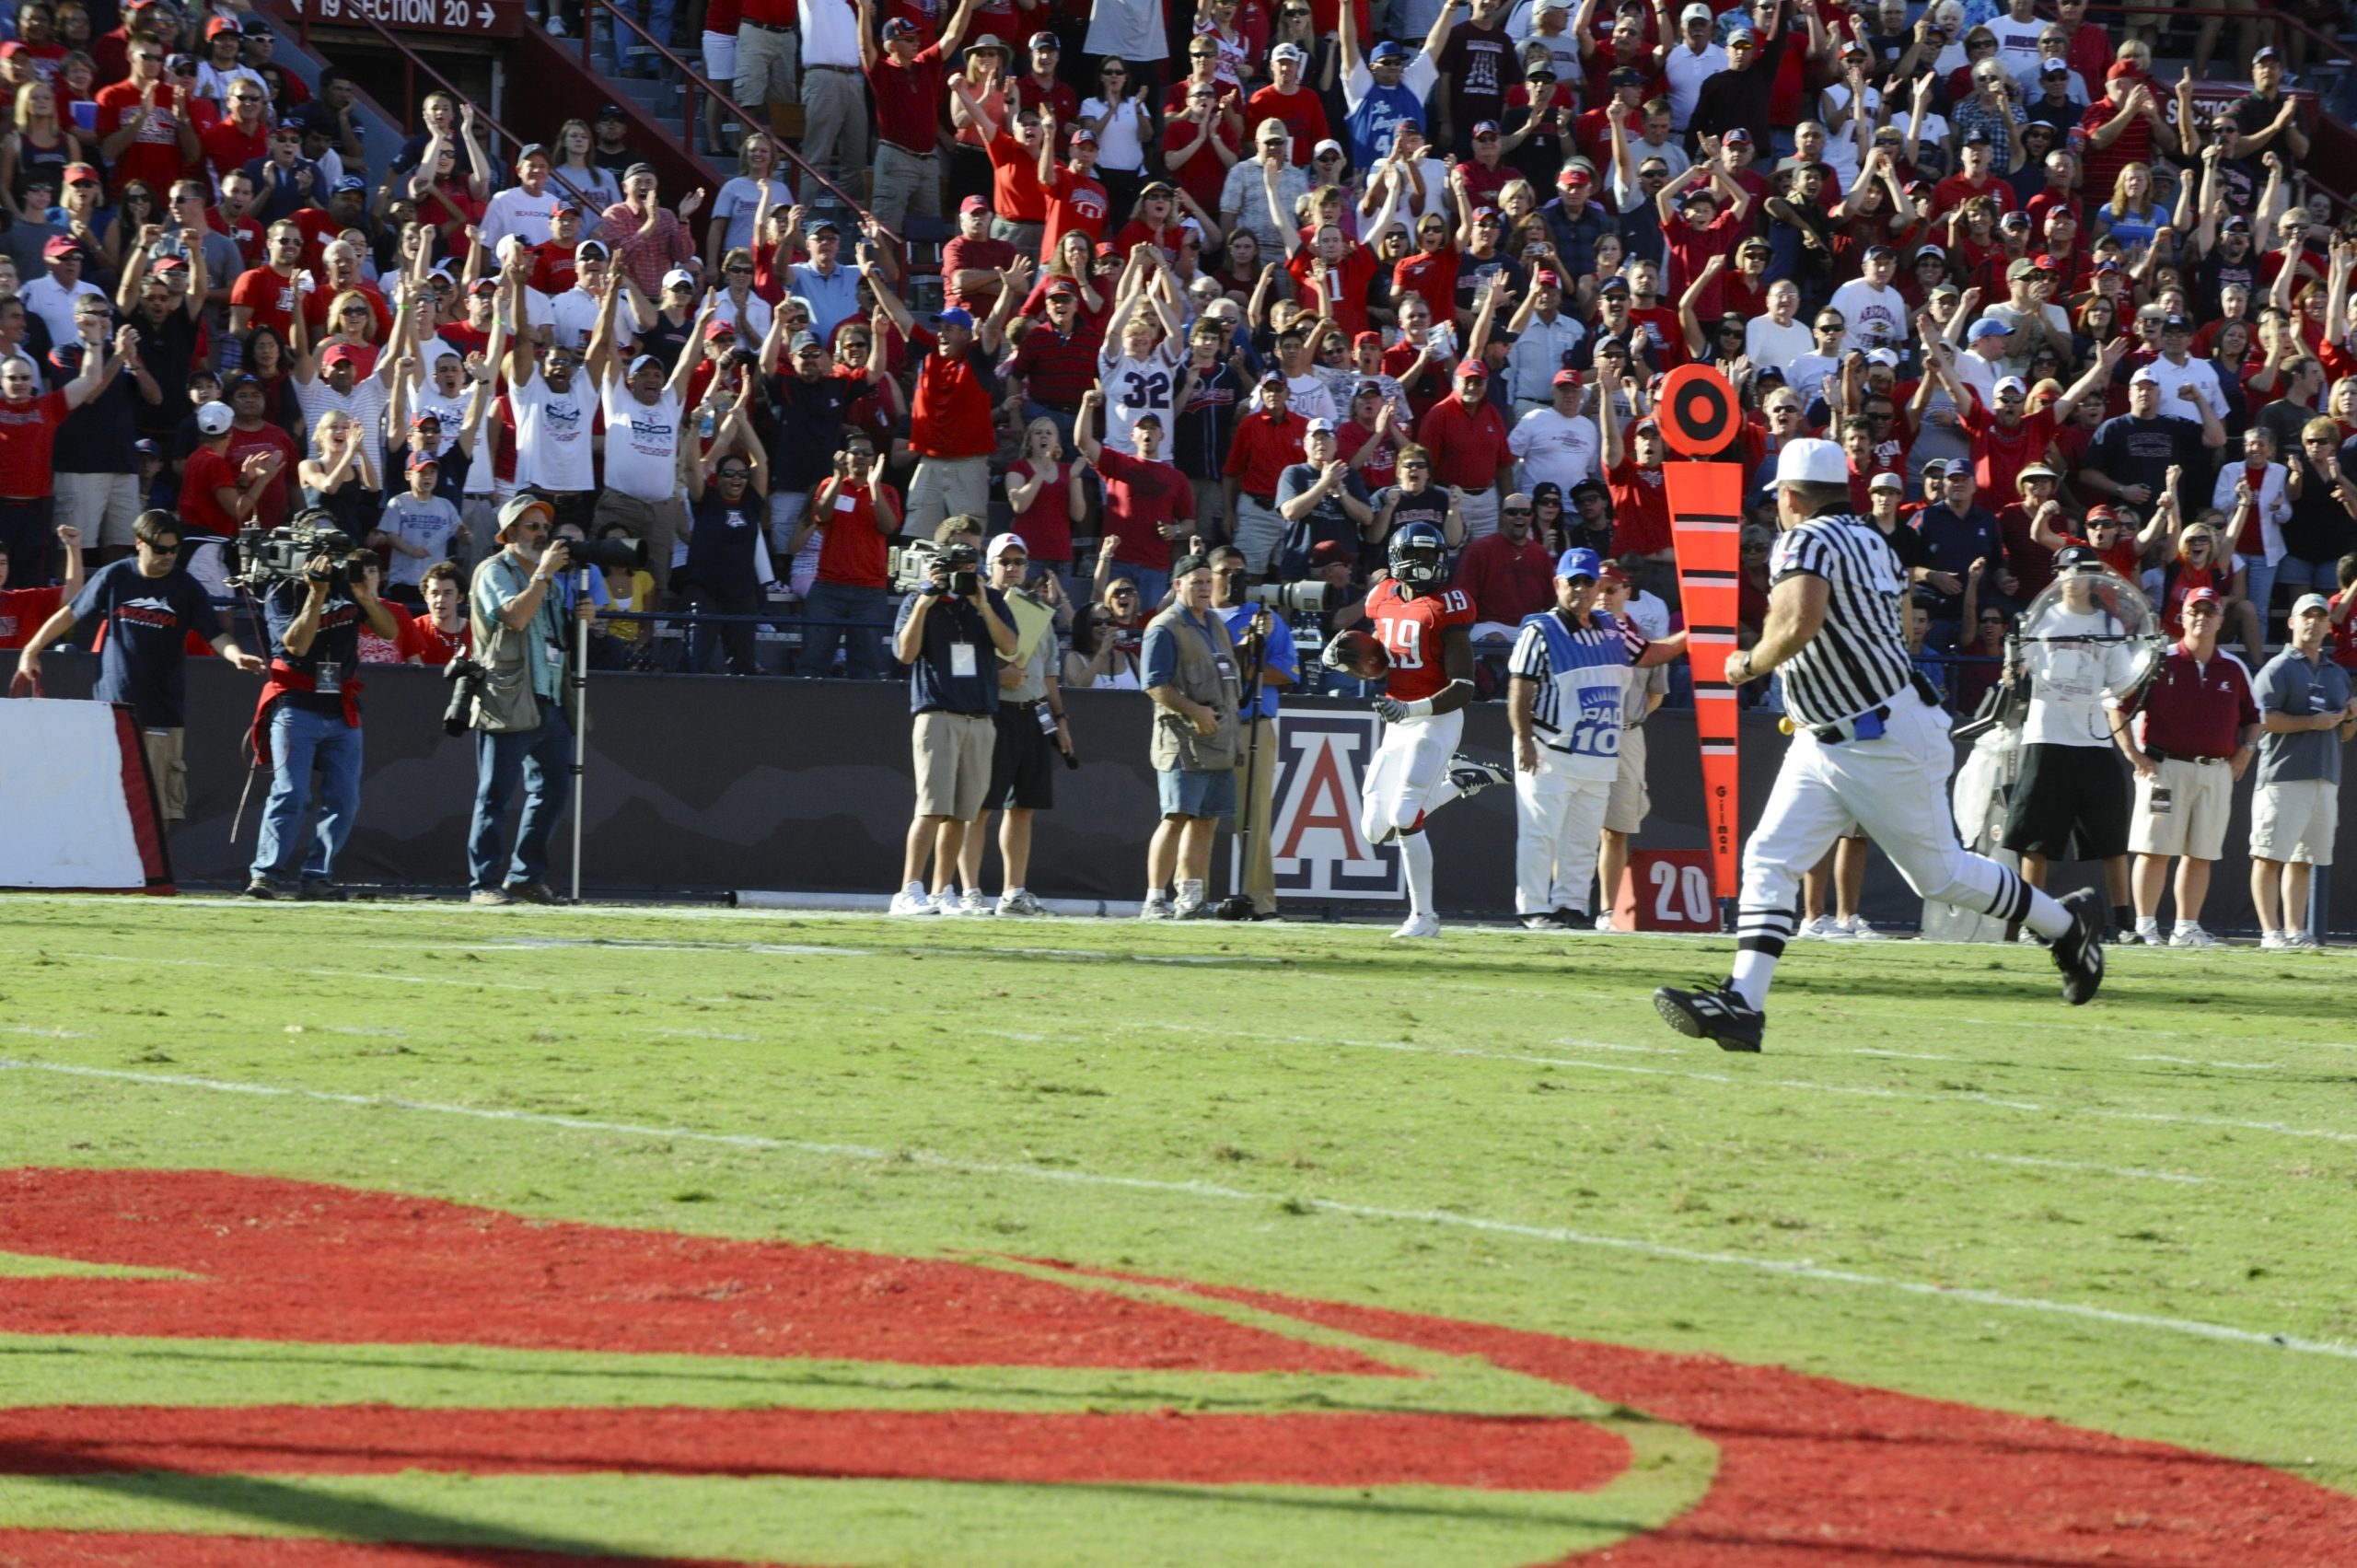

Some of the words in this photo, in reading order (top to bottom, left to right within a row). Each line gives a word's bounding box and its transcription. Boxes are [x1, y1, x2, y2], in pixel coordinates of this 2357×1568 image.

[444, 0, 470, 27] 20
[2165, 98, 2232, 125] SCTIO
[1123, 371, 1170, 409] 32
[1441, 590, 1469, 614] 19
[112, 605, 178, 628] ARIZONA
[1381, 617, 1424, 669] 19
[1575, 726, 1620, 755] 10
[1650, 860, 1713, 923] 20
